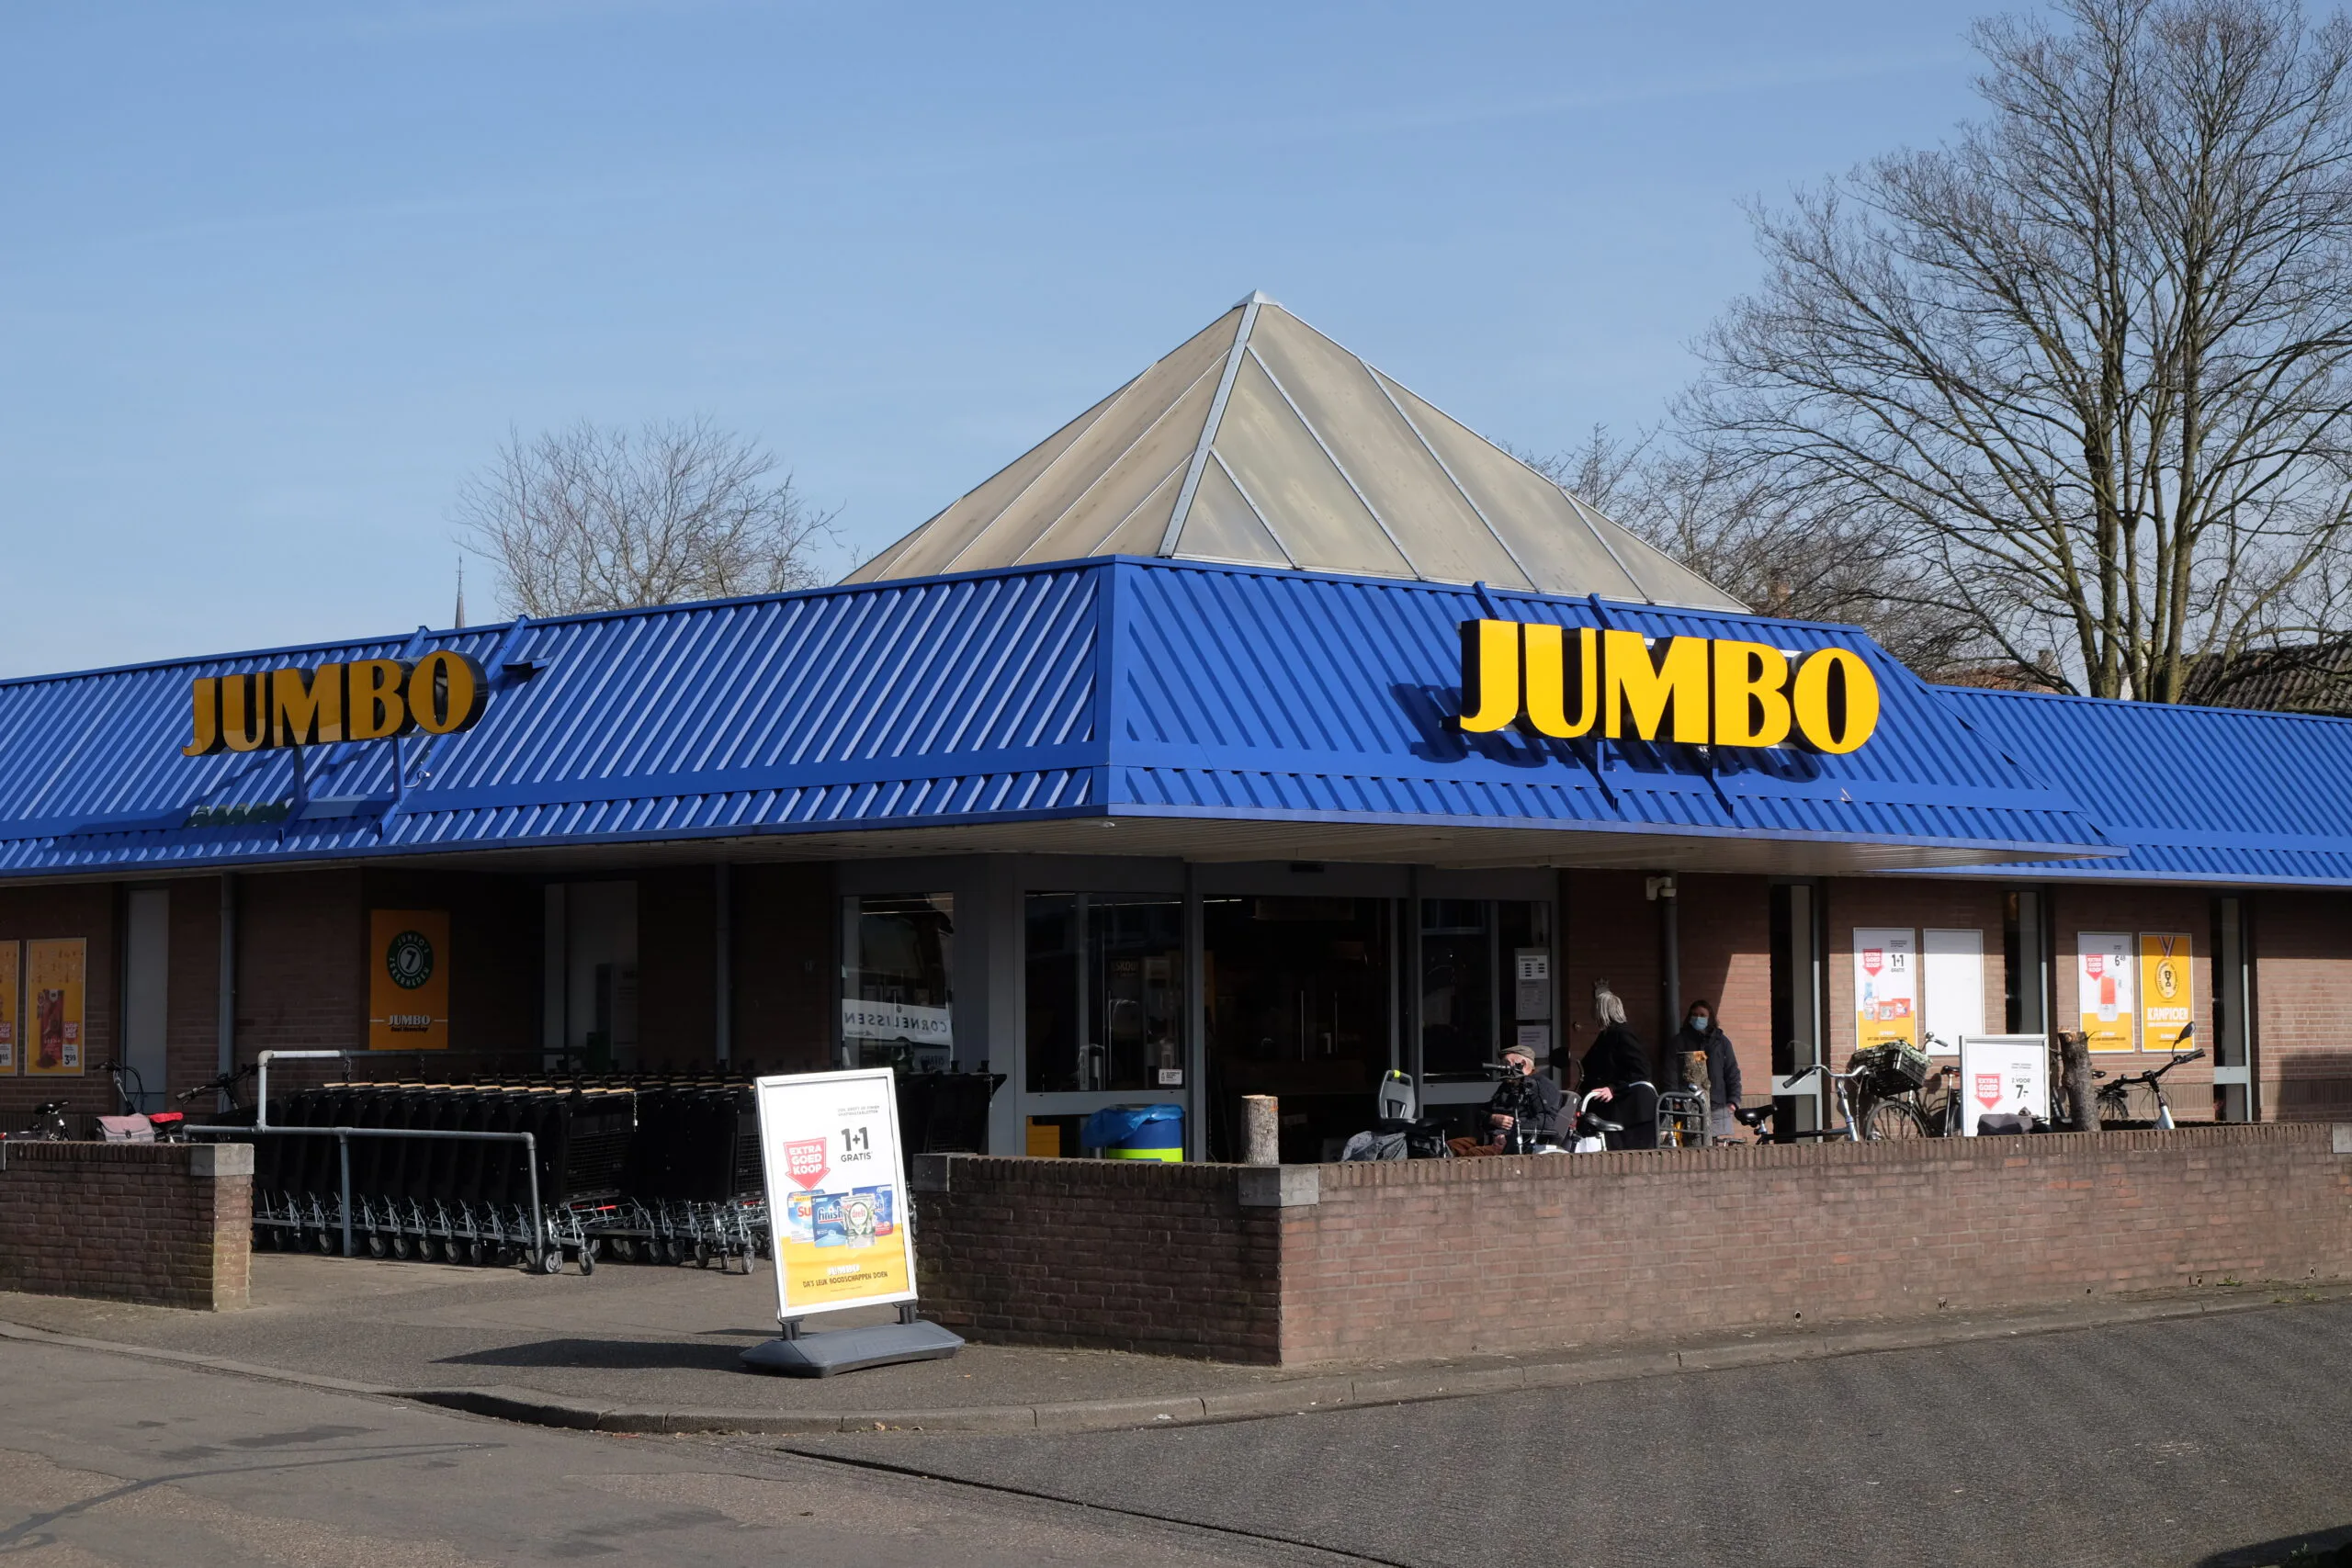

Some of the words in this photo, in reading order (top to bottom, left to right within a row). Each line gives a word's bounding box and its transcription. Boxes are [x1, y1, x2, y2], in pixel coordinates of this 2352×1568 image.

[1459, 618, 1880, 754] JUMBO
[182, 649, 480, 757] JUMBO
[397, 932, 430, 953] JUMBO'S
[406, 949, 417, 971] 7
[1891, 953, 1905, 967] 1+1
[388, 1014, 431, 1026] JUMBO
[841, 1126, 869, 1152] 1+1
[788, 1145, 822, 1156] EXTRA
[841, 1152, 872, 1162] GRATIS
[790, 1154, 822, 1166] GOED
[793, 1163, 822, 1175] KOOP
[828, 1264, 860, 1275] JUMBO
[802, 1280, 815, 1288] DA'S
[816, 1278, 828, 1287] LEUK
[829, 1272, 872, 1284] BOODSCHAPPEN
[873, 1270, 888, 1279] DOEN
